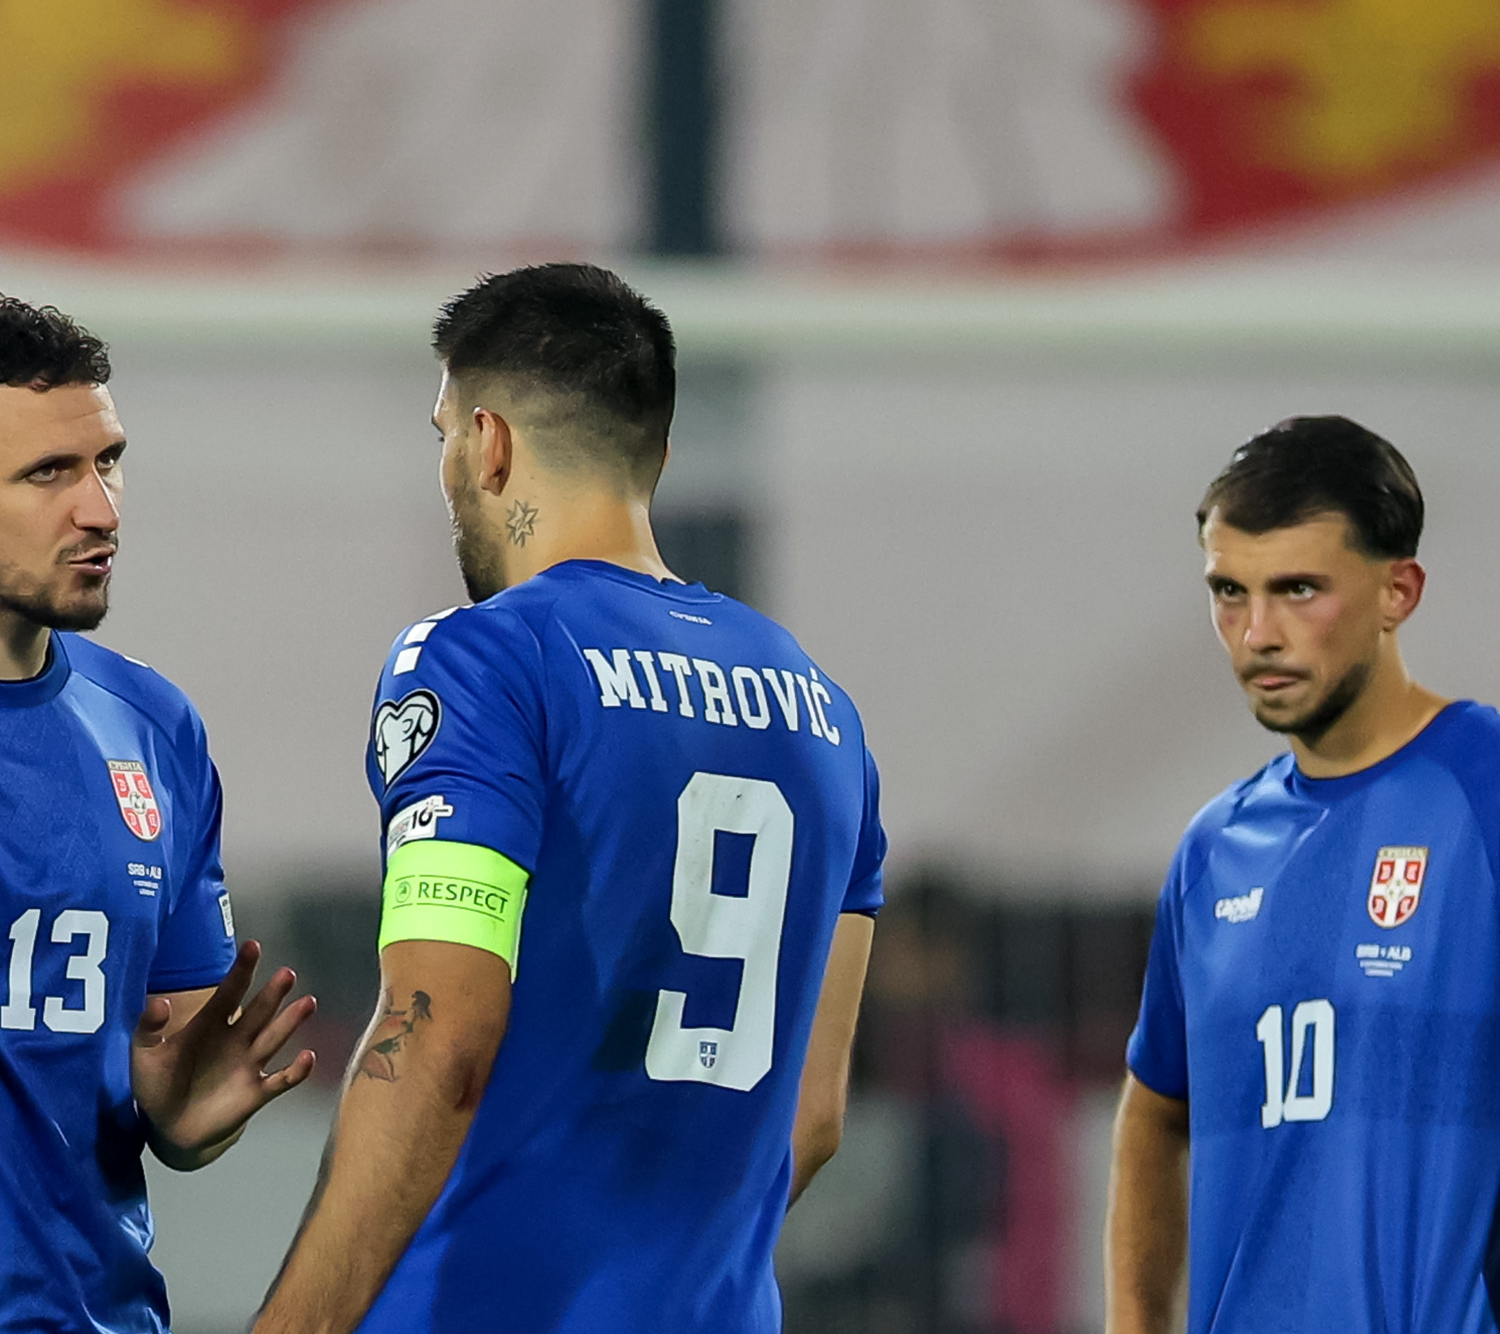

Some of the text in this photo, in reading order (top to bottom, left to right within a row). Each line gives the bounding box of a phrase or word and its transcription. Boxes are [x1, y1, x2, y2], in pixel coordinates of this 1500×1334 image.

[583, 648, 841, 747] MITROVIĆ
[417, 881, 509, 915] RESPECT
[645, 770, 795, 1092] 9
[0, 908, 109, 1034] 13
[1256, 998, 1336, 1129] 10
